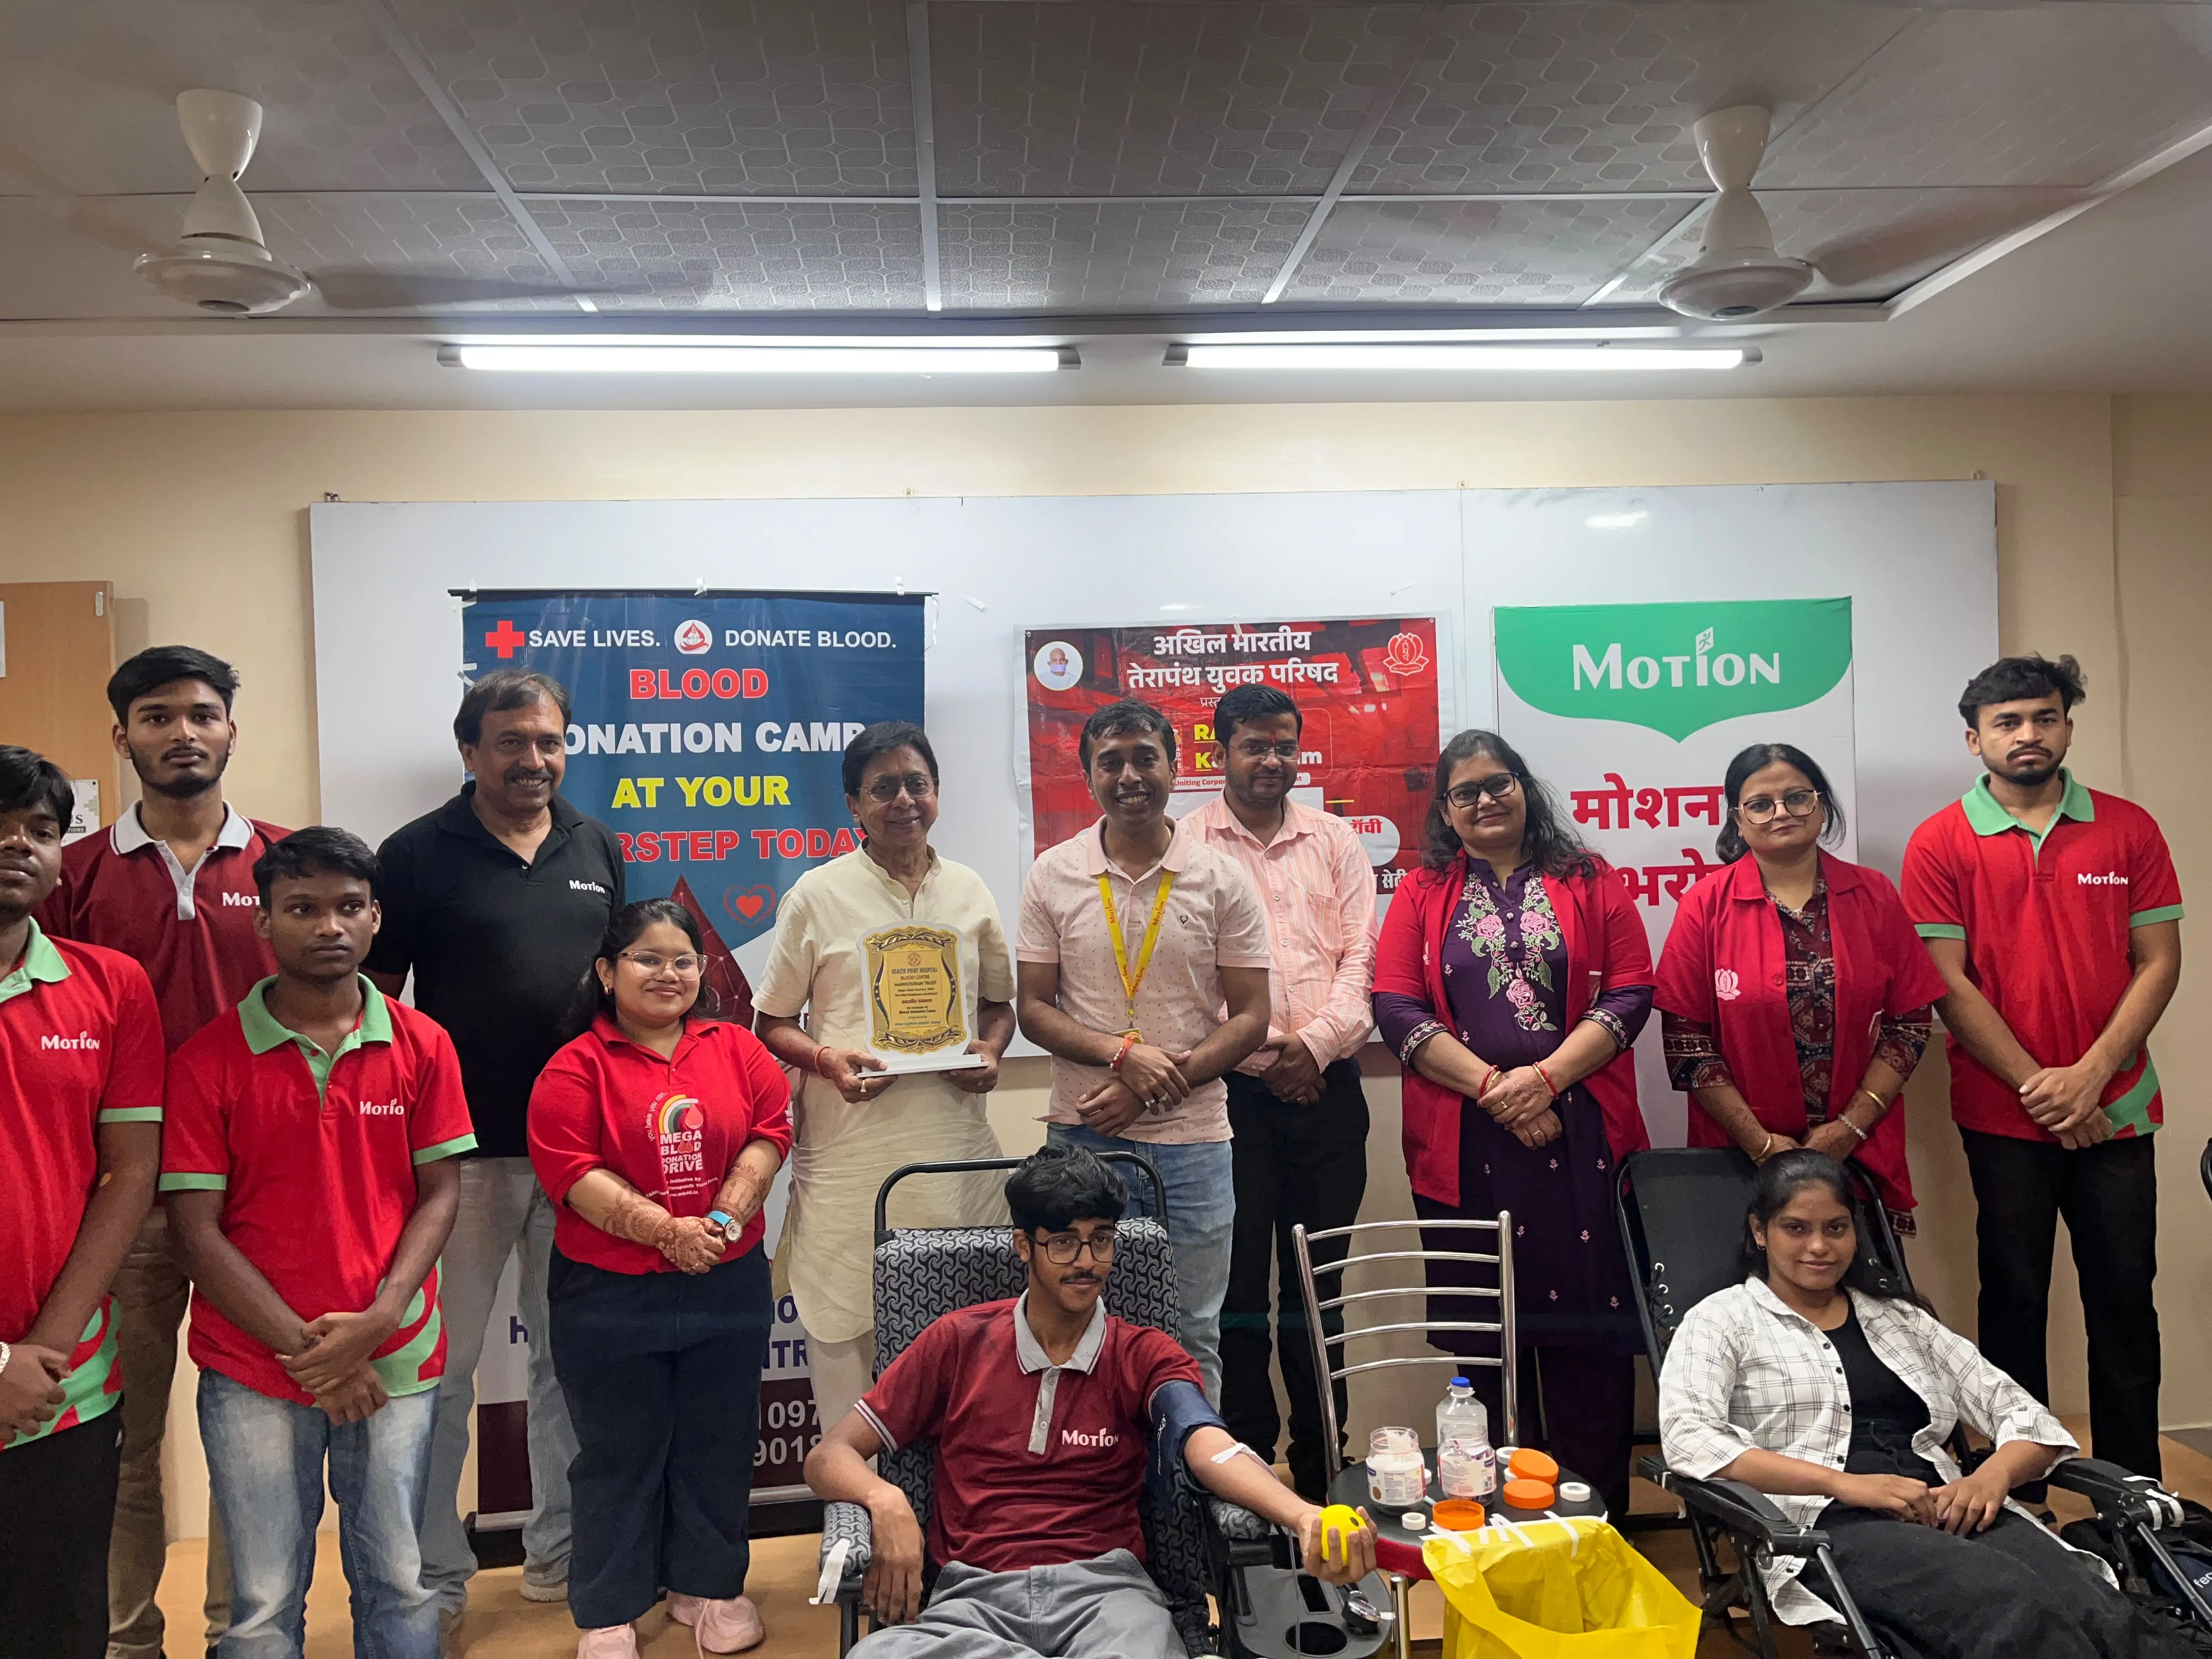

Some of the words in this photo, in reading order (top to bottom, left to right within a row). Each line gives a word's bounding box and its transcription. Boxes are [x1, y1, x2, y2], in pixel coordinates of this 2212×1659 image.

[529, 630, 586, 647] SAVE
[594, 630, 660, 647] LIVES.
[725, 630, 811, 647] DONATE
[817, 630, 896, 648] BLOOD.
[1153, 629, 1228, 656] अखिल
[1232, 625, 1312, 652] भारतीय
[630, 668, 769, 699] BLOOD
[1126, 662, 1203, 689] तेरापंथ
[1205, 665, 1265, 694] युवक
[1269, 657, 1339, 684] परिषद
[565, 722, 742, 755] ONATION
[611, 777, 664, 809] AT
[675, 775, 791, 808] YOUR
[1570, 772, 1724, 830] मोशन
[617, 829, 740, 864] RSTEP
[660, 1130, 702, 1145] MEGA
[661, 1152, 702, 1164] DONATION
[662, 1159, 703, 1175] DRIVE
